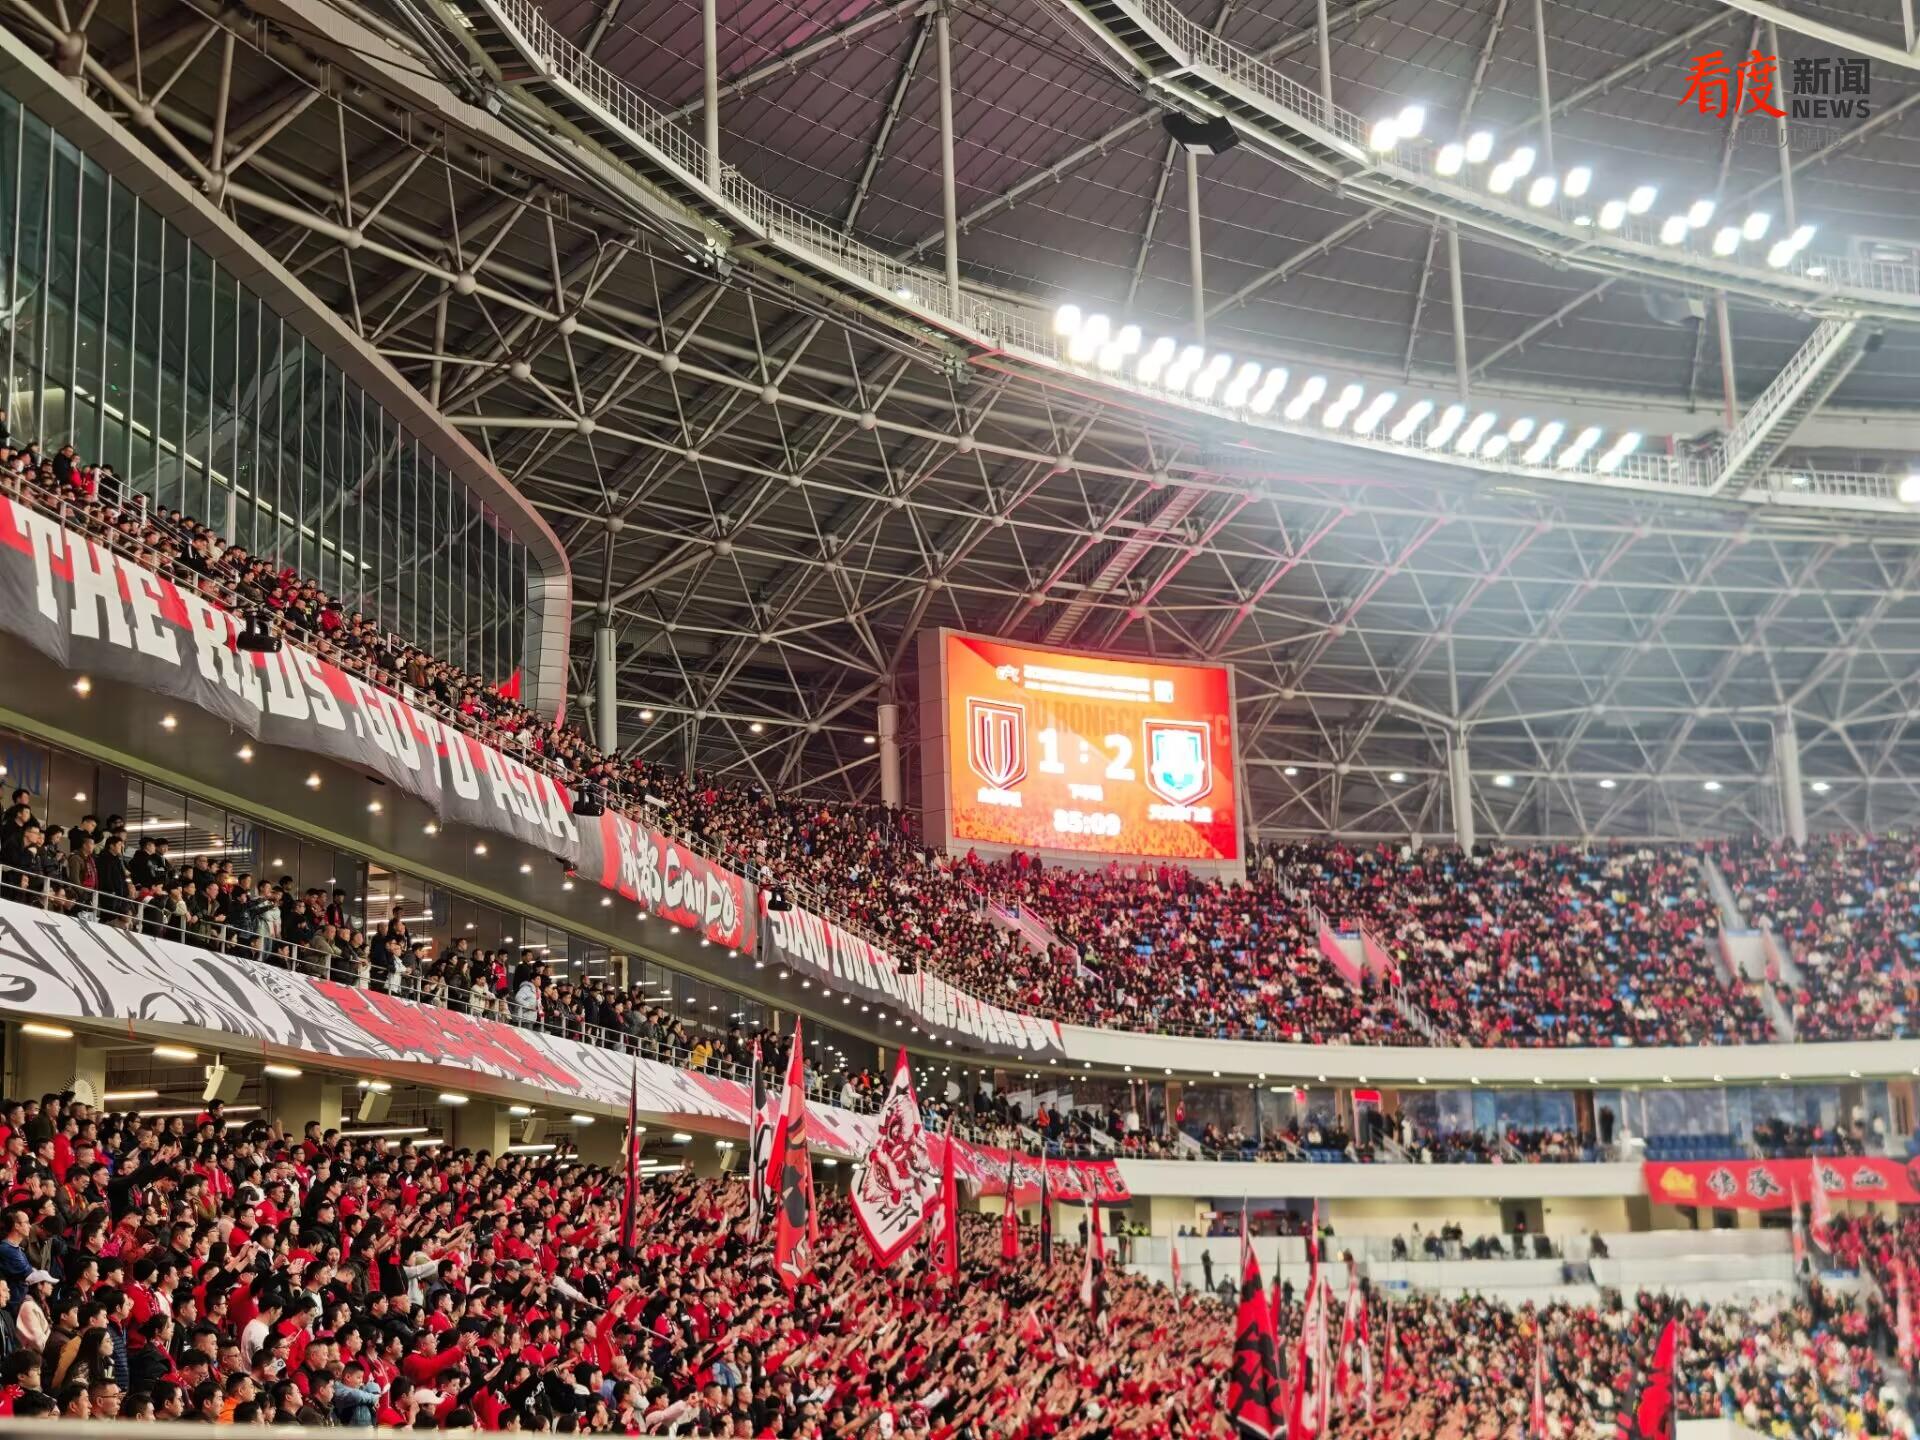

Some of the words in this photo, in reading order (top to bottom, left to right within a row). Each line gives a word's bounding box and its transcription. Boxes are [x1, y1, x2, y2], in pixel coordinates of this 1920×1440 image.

[12, 499, 181, 666] THE
[408, 703, 480, 801] TO
[480, 743, 580, 843] ASIA
[1037, 727, 1066, 775] 1
[1104, 734, 1136, 781] 2
